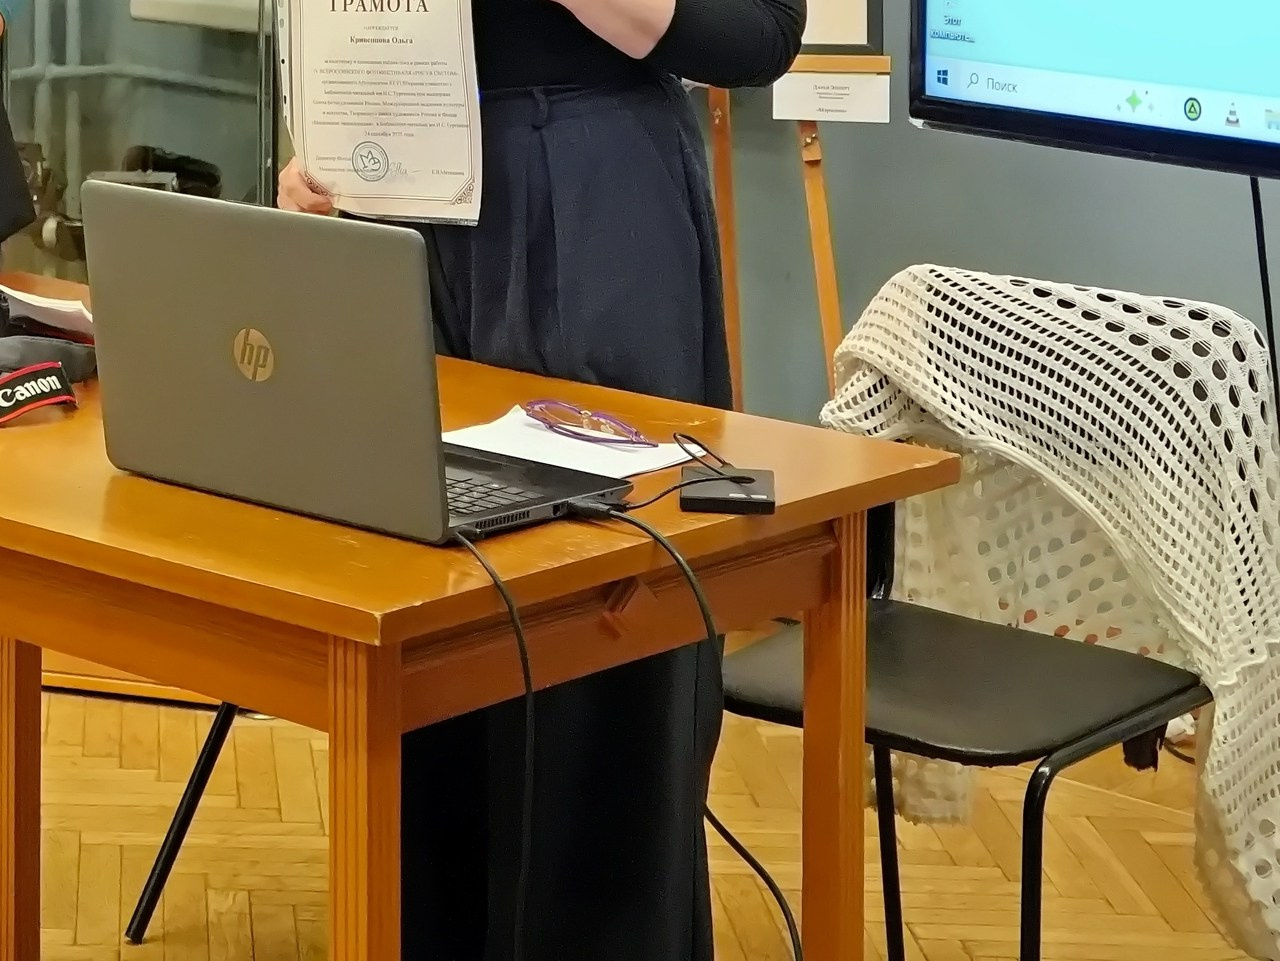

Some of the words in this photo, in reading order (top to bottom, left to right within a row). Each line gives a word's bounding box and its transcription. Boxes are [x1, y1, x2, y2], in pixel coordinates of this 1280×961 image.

[943, 15, 962, 26] Этот
[391, 36, 414, 44] Ольга
[986, 77, 1019, 93] Поиск
[238, 328, 271, 381] hp
